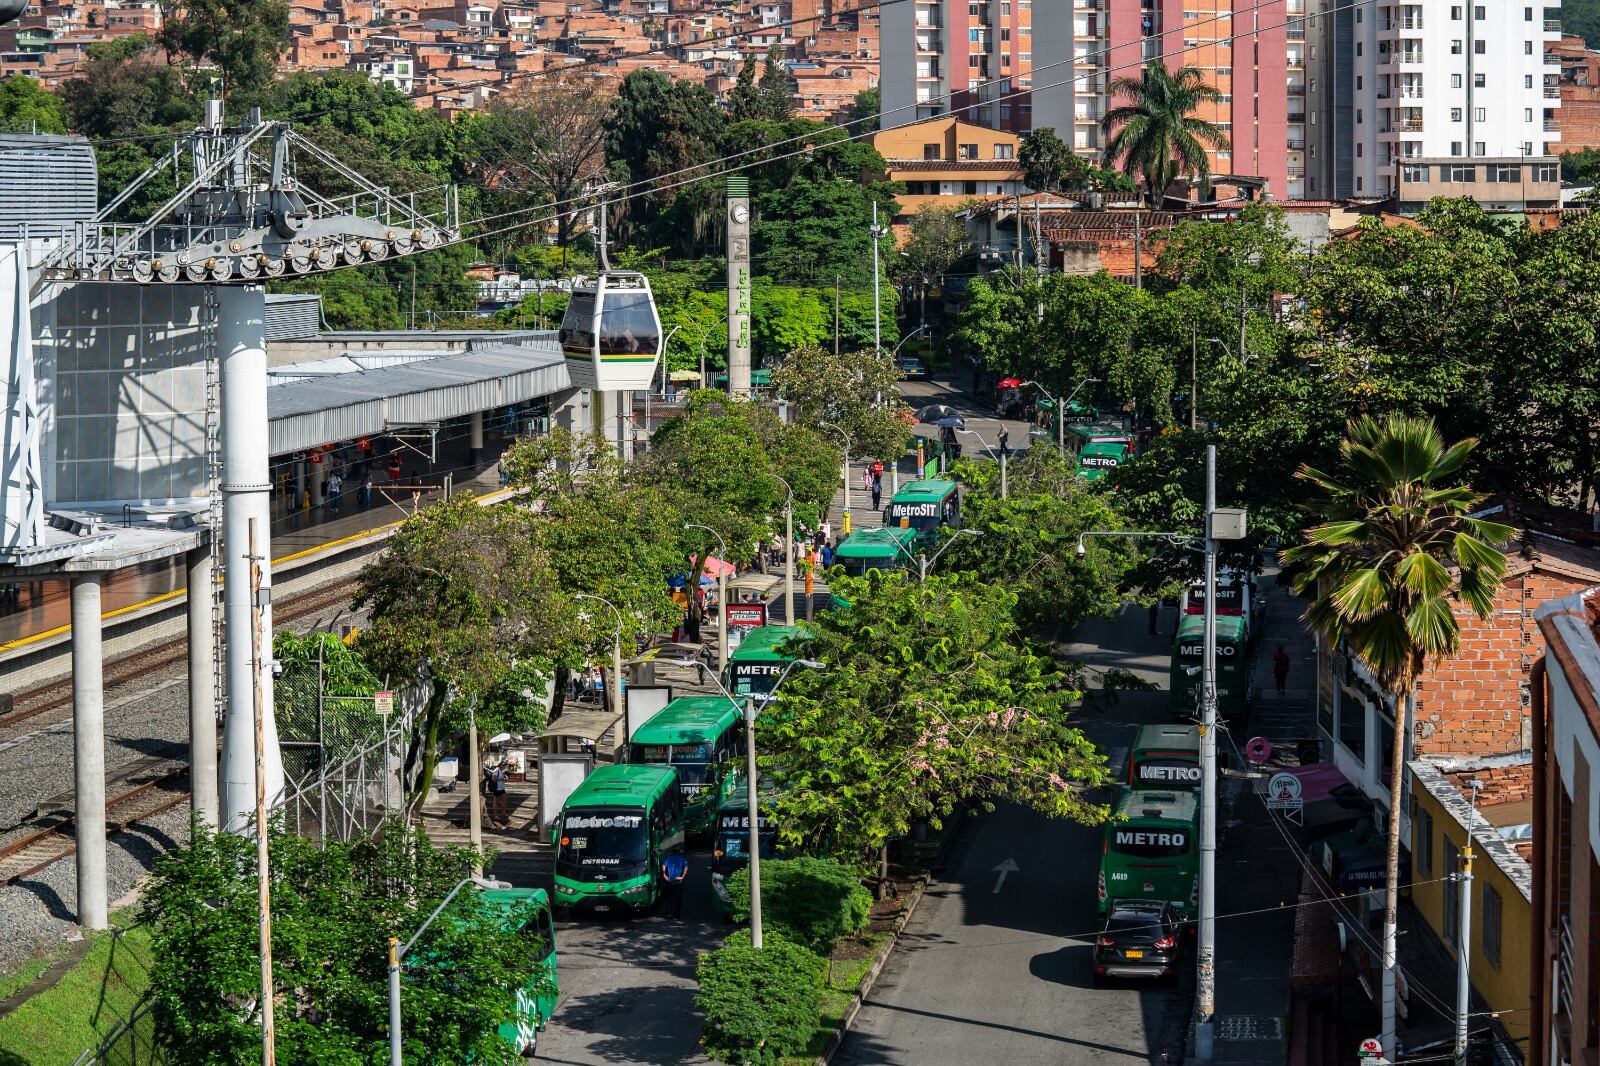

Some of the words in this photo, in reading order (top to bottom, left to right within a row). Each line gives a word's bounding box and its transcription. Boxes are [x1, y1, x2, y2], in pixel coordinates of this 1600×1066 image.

[735, 268, 751, 317] Javier
[736, 320, 749, 349] San
[1082, 457, 1117, 467] METRO
[892, 503, 937, 517] MetroSIT
[1194, 590, 1236, 598] MeoSIT
[1180, 645, 1235, 656] MERO
[736, 665, 786, 675] METR
[1140, 766, 1202, 781] METRO
[566, 815, 642, 829] MetroSIT
[1116, 831, 1185, 846] METRO
